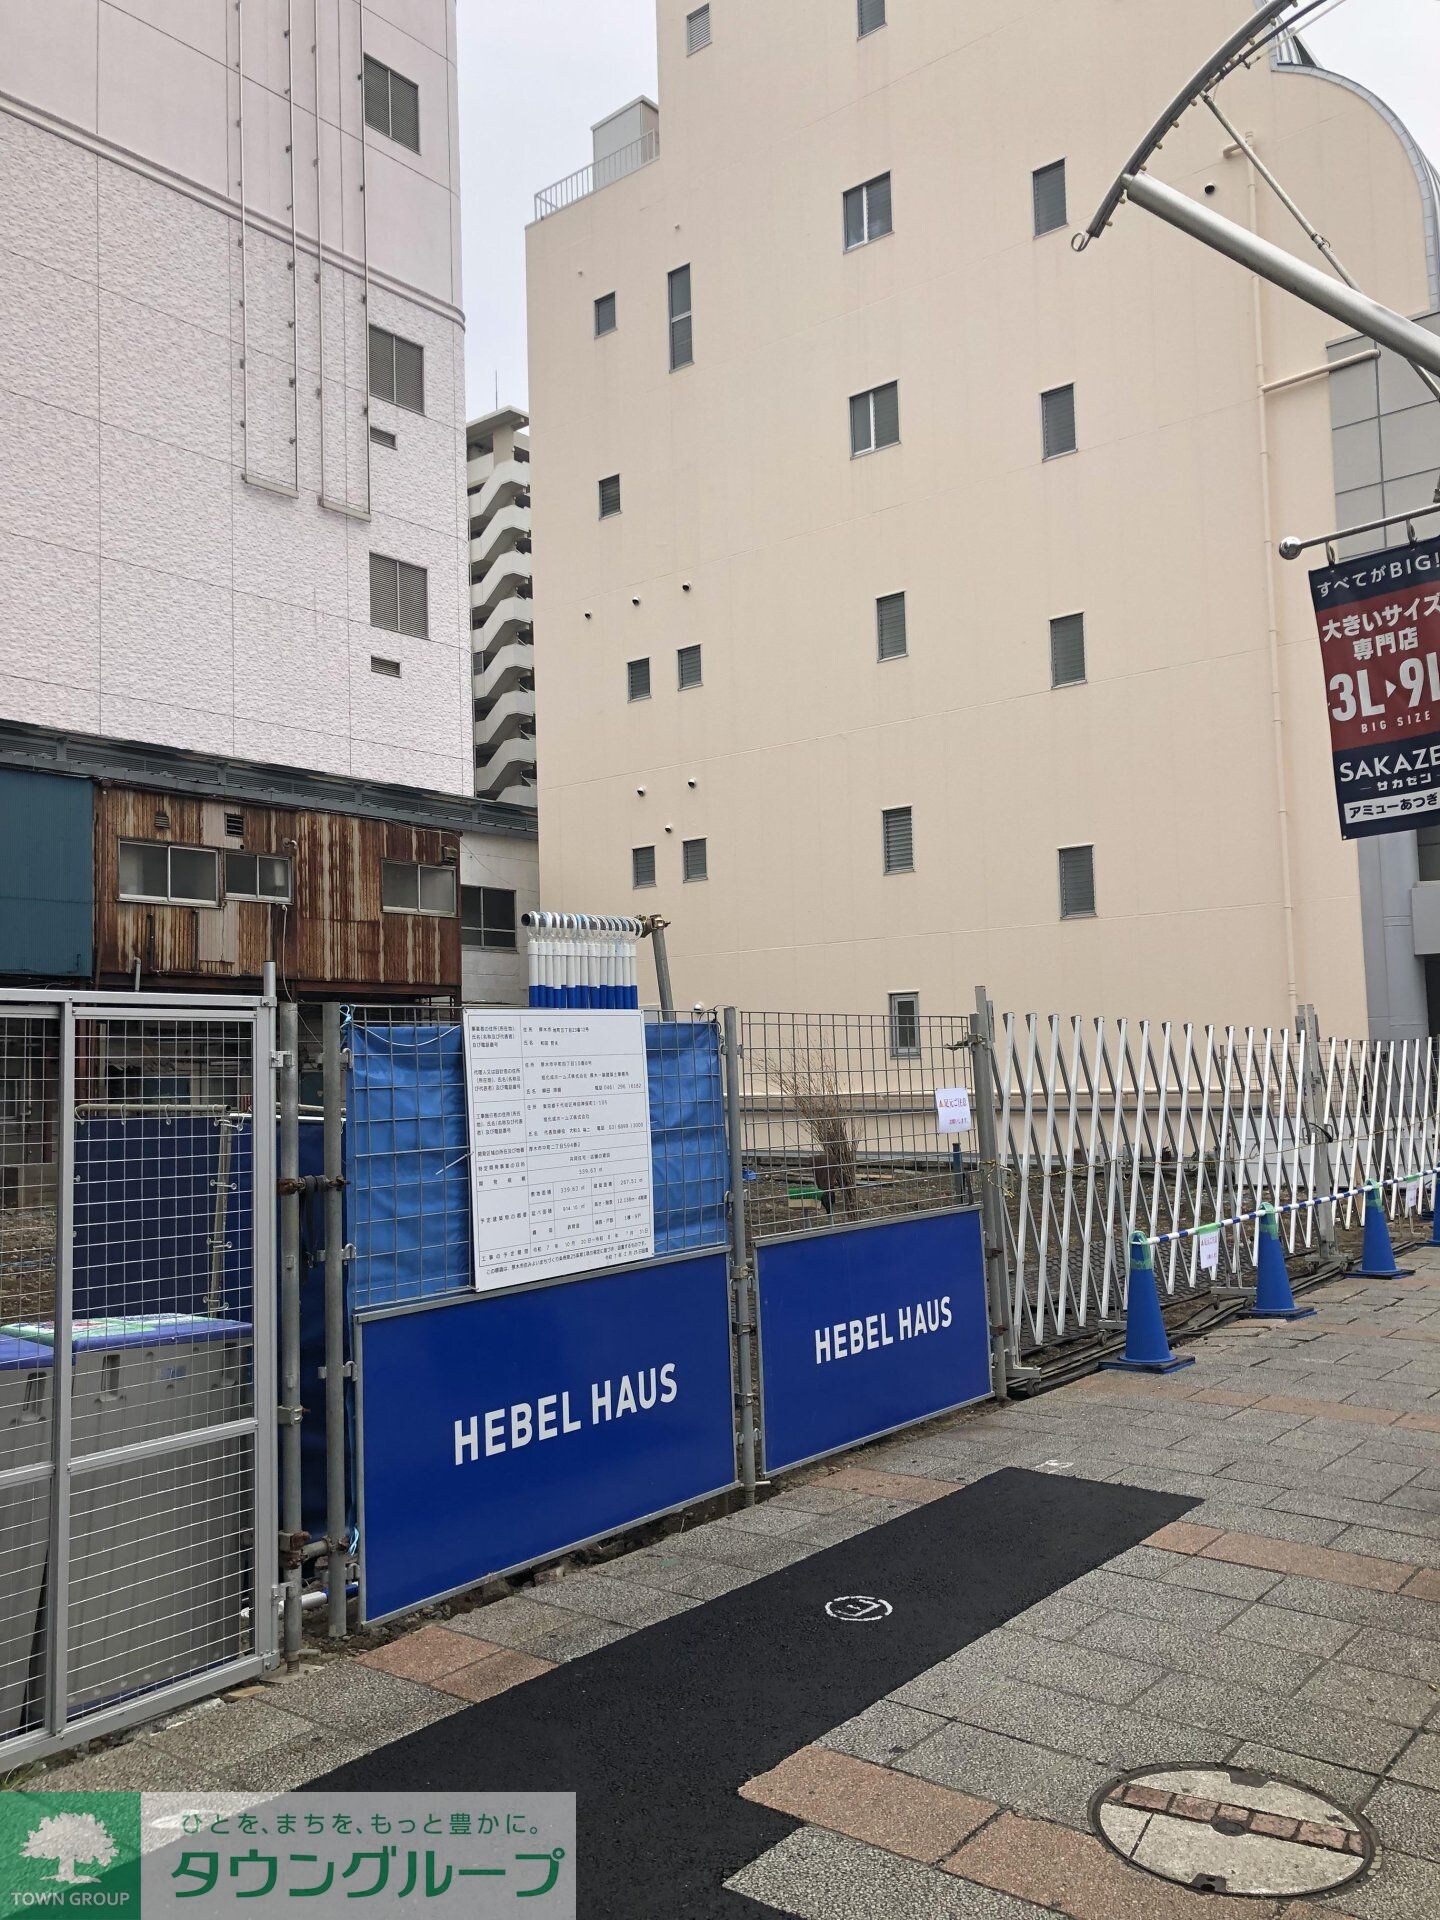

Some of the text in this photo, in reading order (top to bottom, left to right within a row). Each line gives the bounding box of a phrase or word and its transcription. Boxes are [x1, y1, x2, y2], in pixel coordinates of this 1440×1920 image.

[1323, 593, 1440, 642] 大きいサイズ
[1353, 626, 1418, 660] 専門店
[1361, 710, 1431, 733] BIG SIZE
[1377, 773, 1432, 791] サカゼン
[1349, 792, 1438, 819] アミューあつぎ
[814, 1296, 953, 1365] HEBEL HAUS
[454, 1362, 679, 1466] HEBEL HAUS
